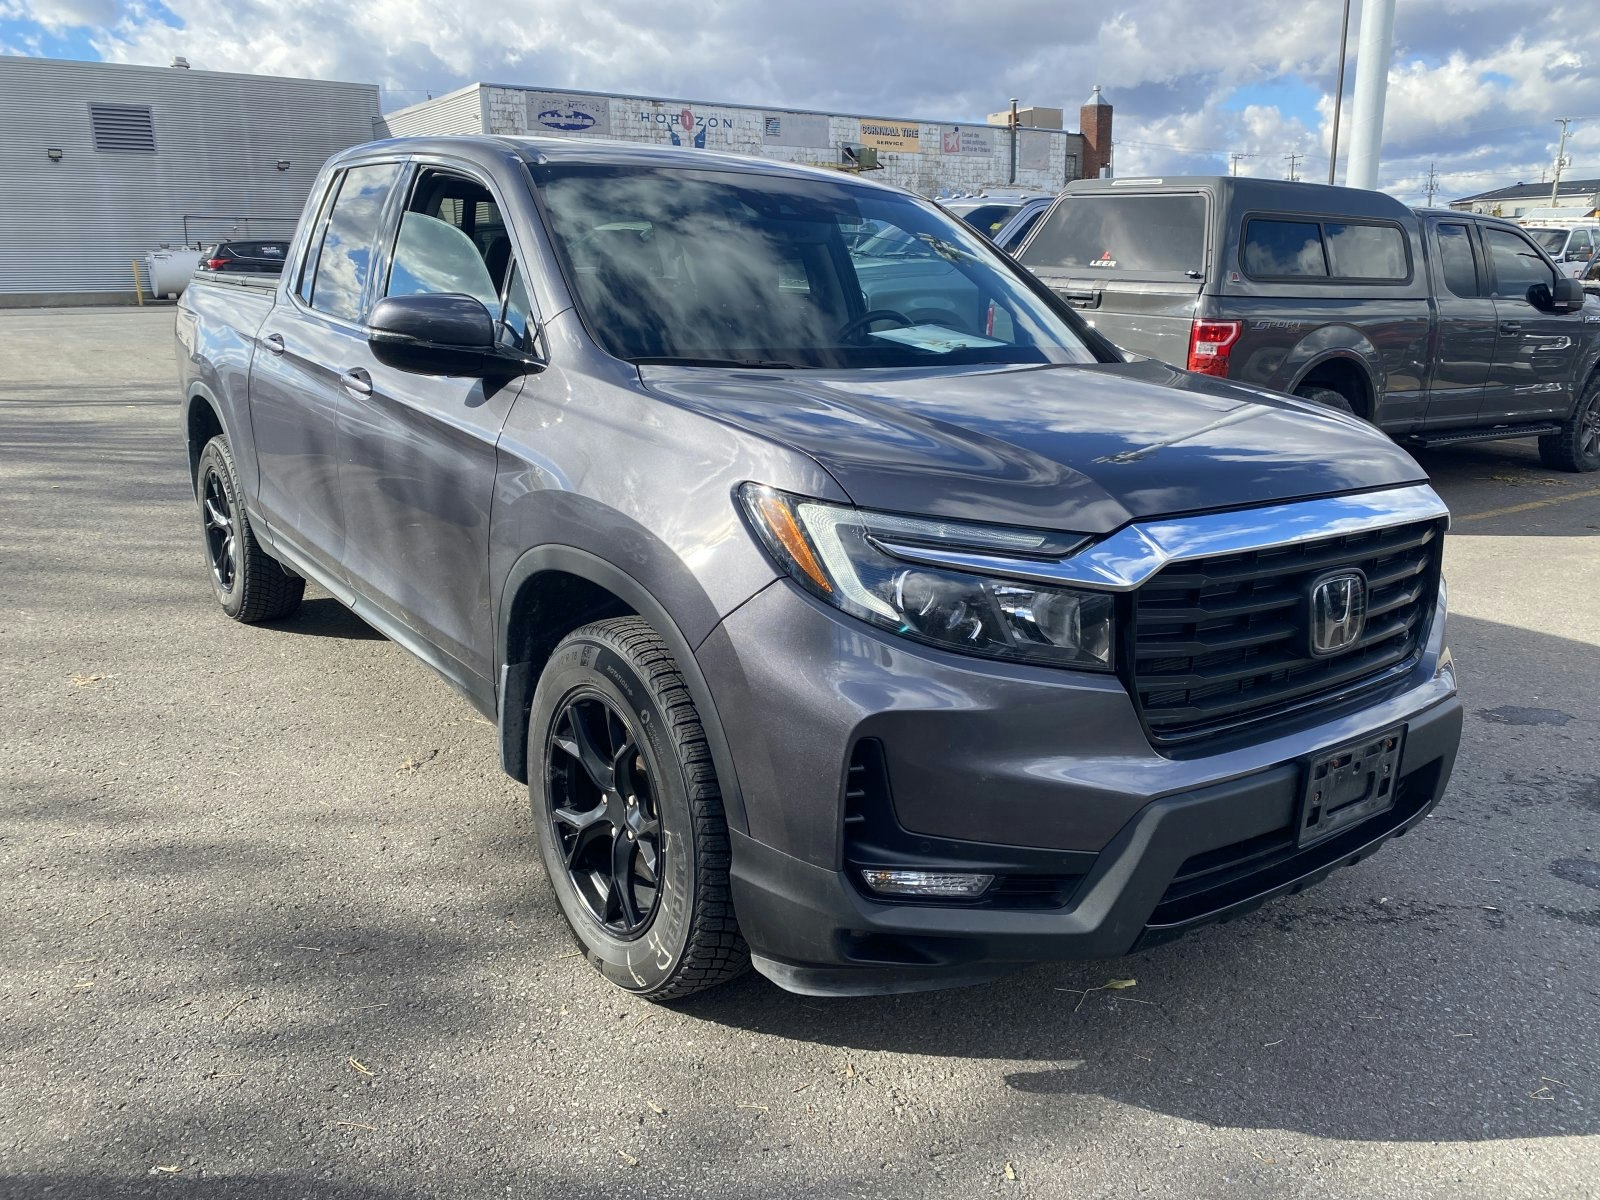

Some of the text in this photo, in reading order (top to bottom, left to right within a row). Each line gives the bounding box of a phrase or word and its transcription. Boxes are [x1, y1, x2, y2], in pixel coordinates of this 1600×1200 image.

[641, 112, 732, 128] HORIZON
[862, 124, 919, 138] CORNWALL TIRE
[1089, 259, 1117, 268] LEER
[1251, 320, 1301, 331] SPORT
